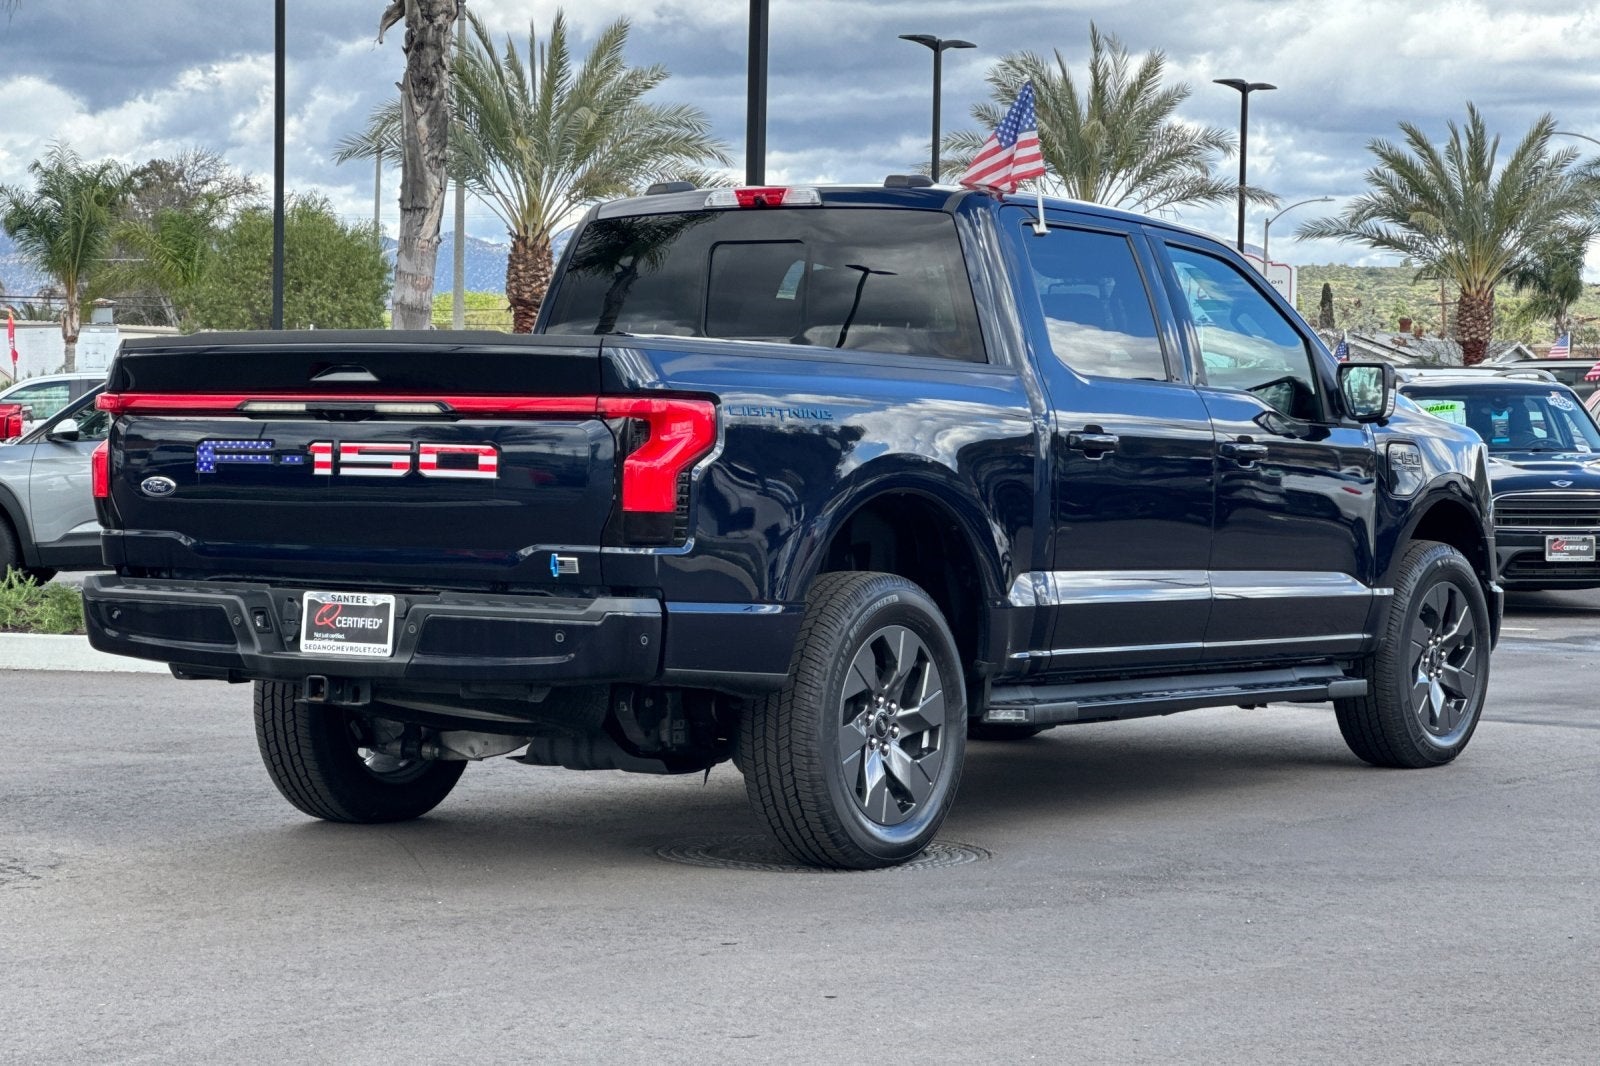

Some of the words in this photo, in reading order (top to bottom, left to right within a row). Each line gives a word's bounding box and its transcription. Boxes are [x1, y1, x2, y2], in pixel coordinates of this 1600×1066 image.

[728, 405, 834, 421] LIGHTNING
[195, 439, 500, 479] F-150
[331, 594, 368, 604] SANTEE
[304, 643, 388, 654] SEDANOCHEVROLET.COM
